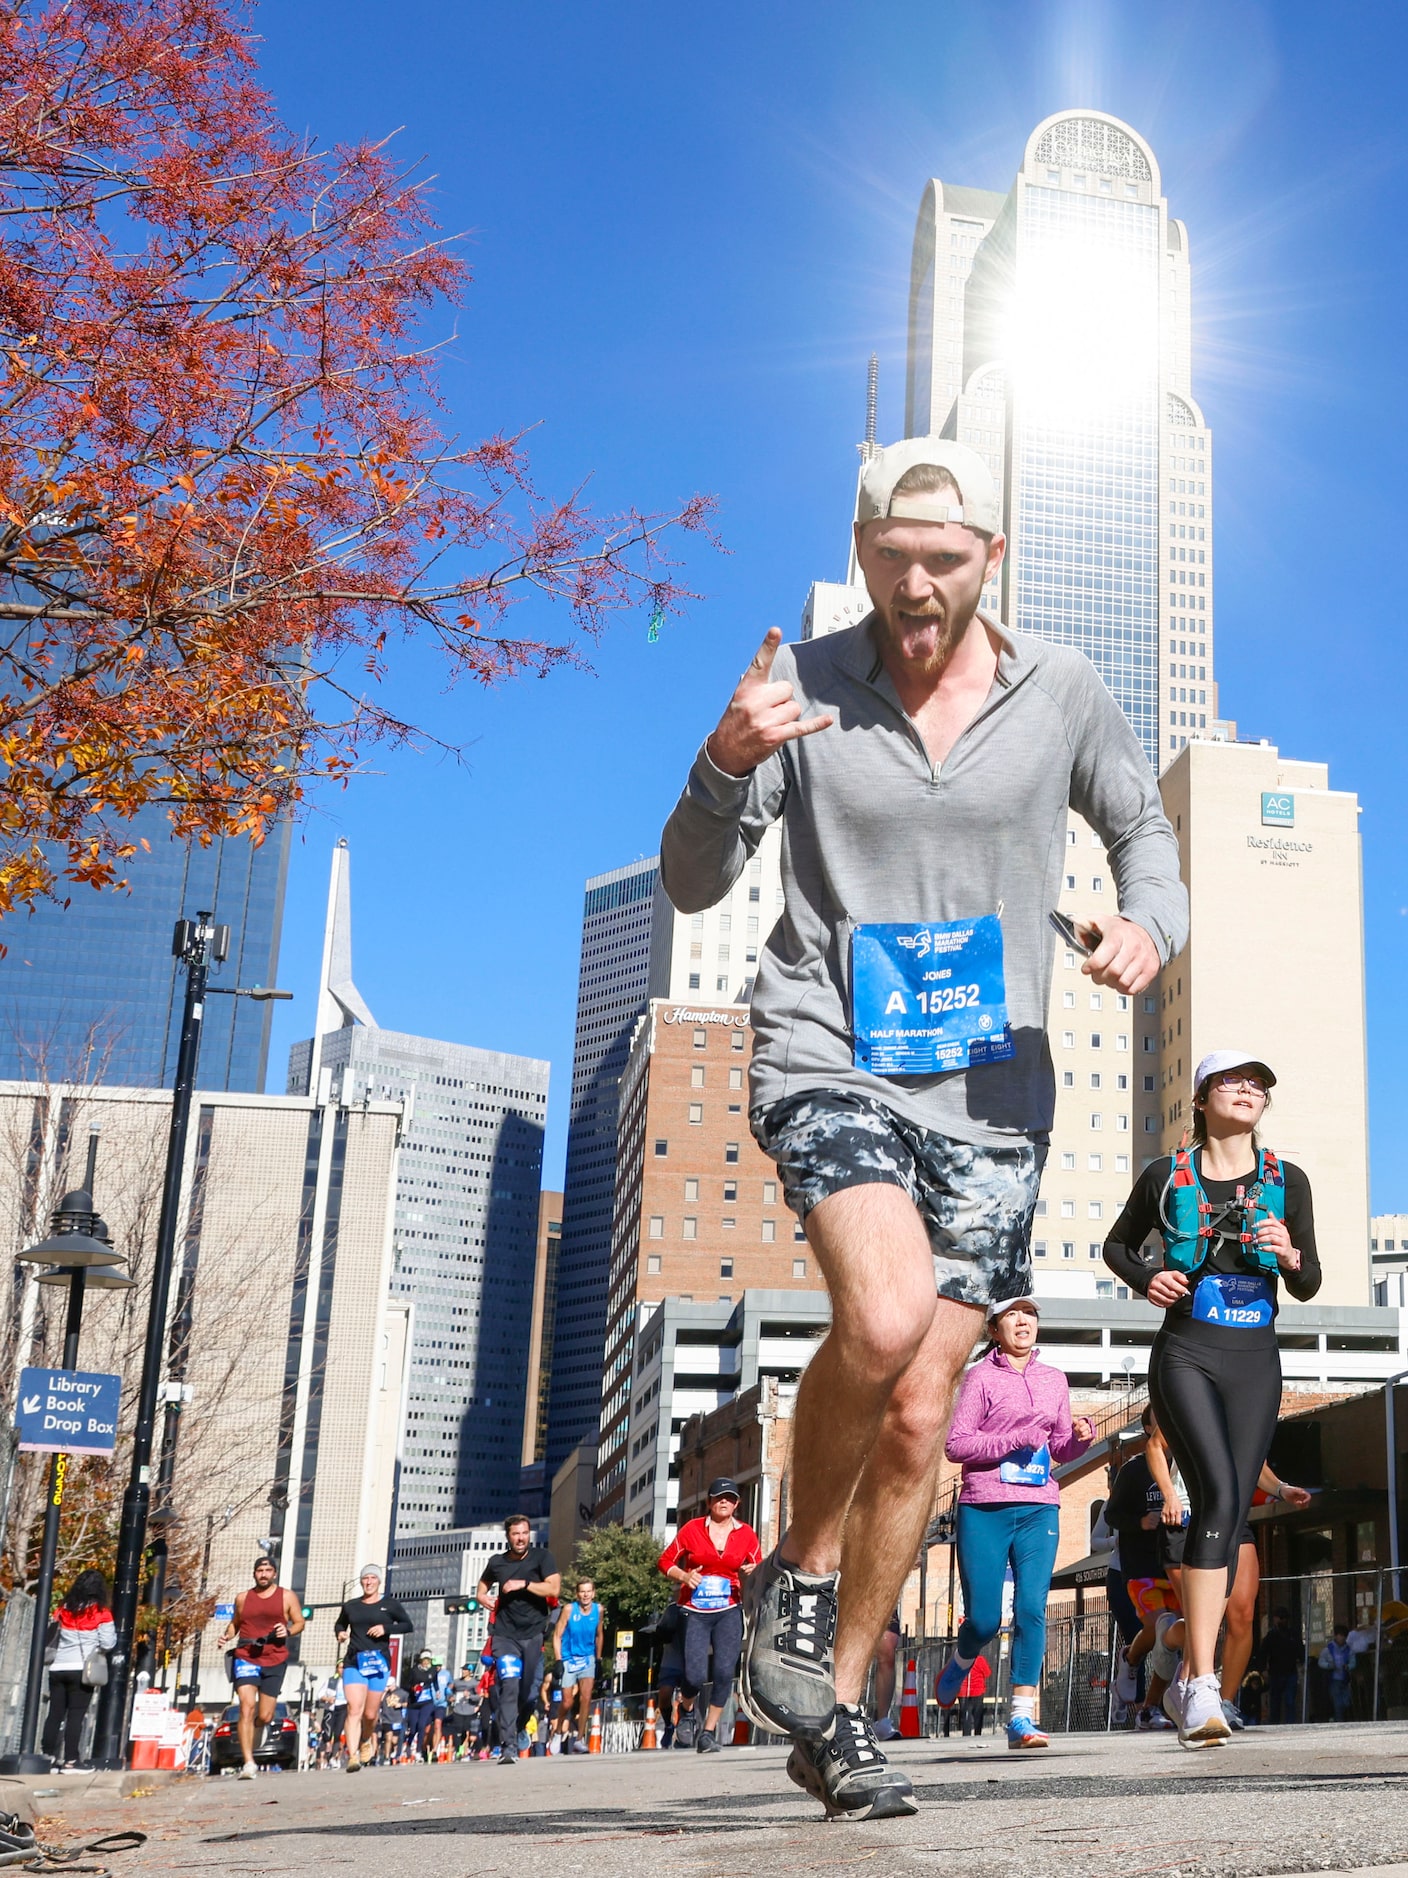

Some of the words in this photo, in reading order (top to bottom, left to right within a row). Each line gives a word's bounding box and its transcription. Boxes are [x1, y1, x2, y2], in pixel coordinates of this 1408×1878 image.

[1266, 797, 1291, 811] AC
[1246, 835, 1313, 853] Residence
[934, 932, 951, 940] BMW
[951, 929, 974, 939] DALLAS
[934, 937, 969, 947] MARATHON
[934, 945, 963, 954] FESTIVAL
[922, 968, 952, 981] JONES
[884, 990, 907, 1015] A
[915, 983, 980, 1014] 15252
[663, 1006, 735, 1025] Hampton
[870, 1030, 894, 1038] HALF
[895, 1027, 943, 1038] MARATHON
[935, 1046, 964, 1060] 15252
[990, 1042, 1012, 1052] EIGHT
[1207, 1306, 1219, 1320] A
[1223, 1308, 1261, 1323] 11229
[48, 1376, 102, 1398] Library
[46, 1395, 86, 1413] Book
[43, 1414, 82, 1435] Drop
[87, 1418, 114, 1434] Box
